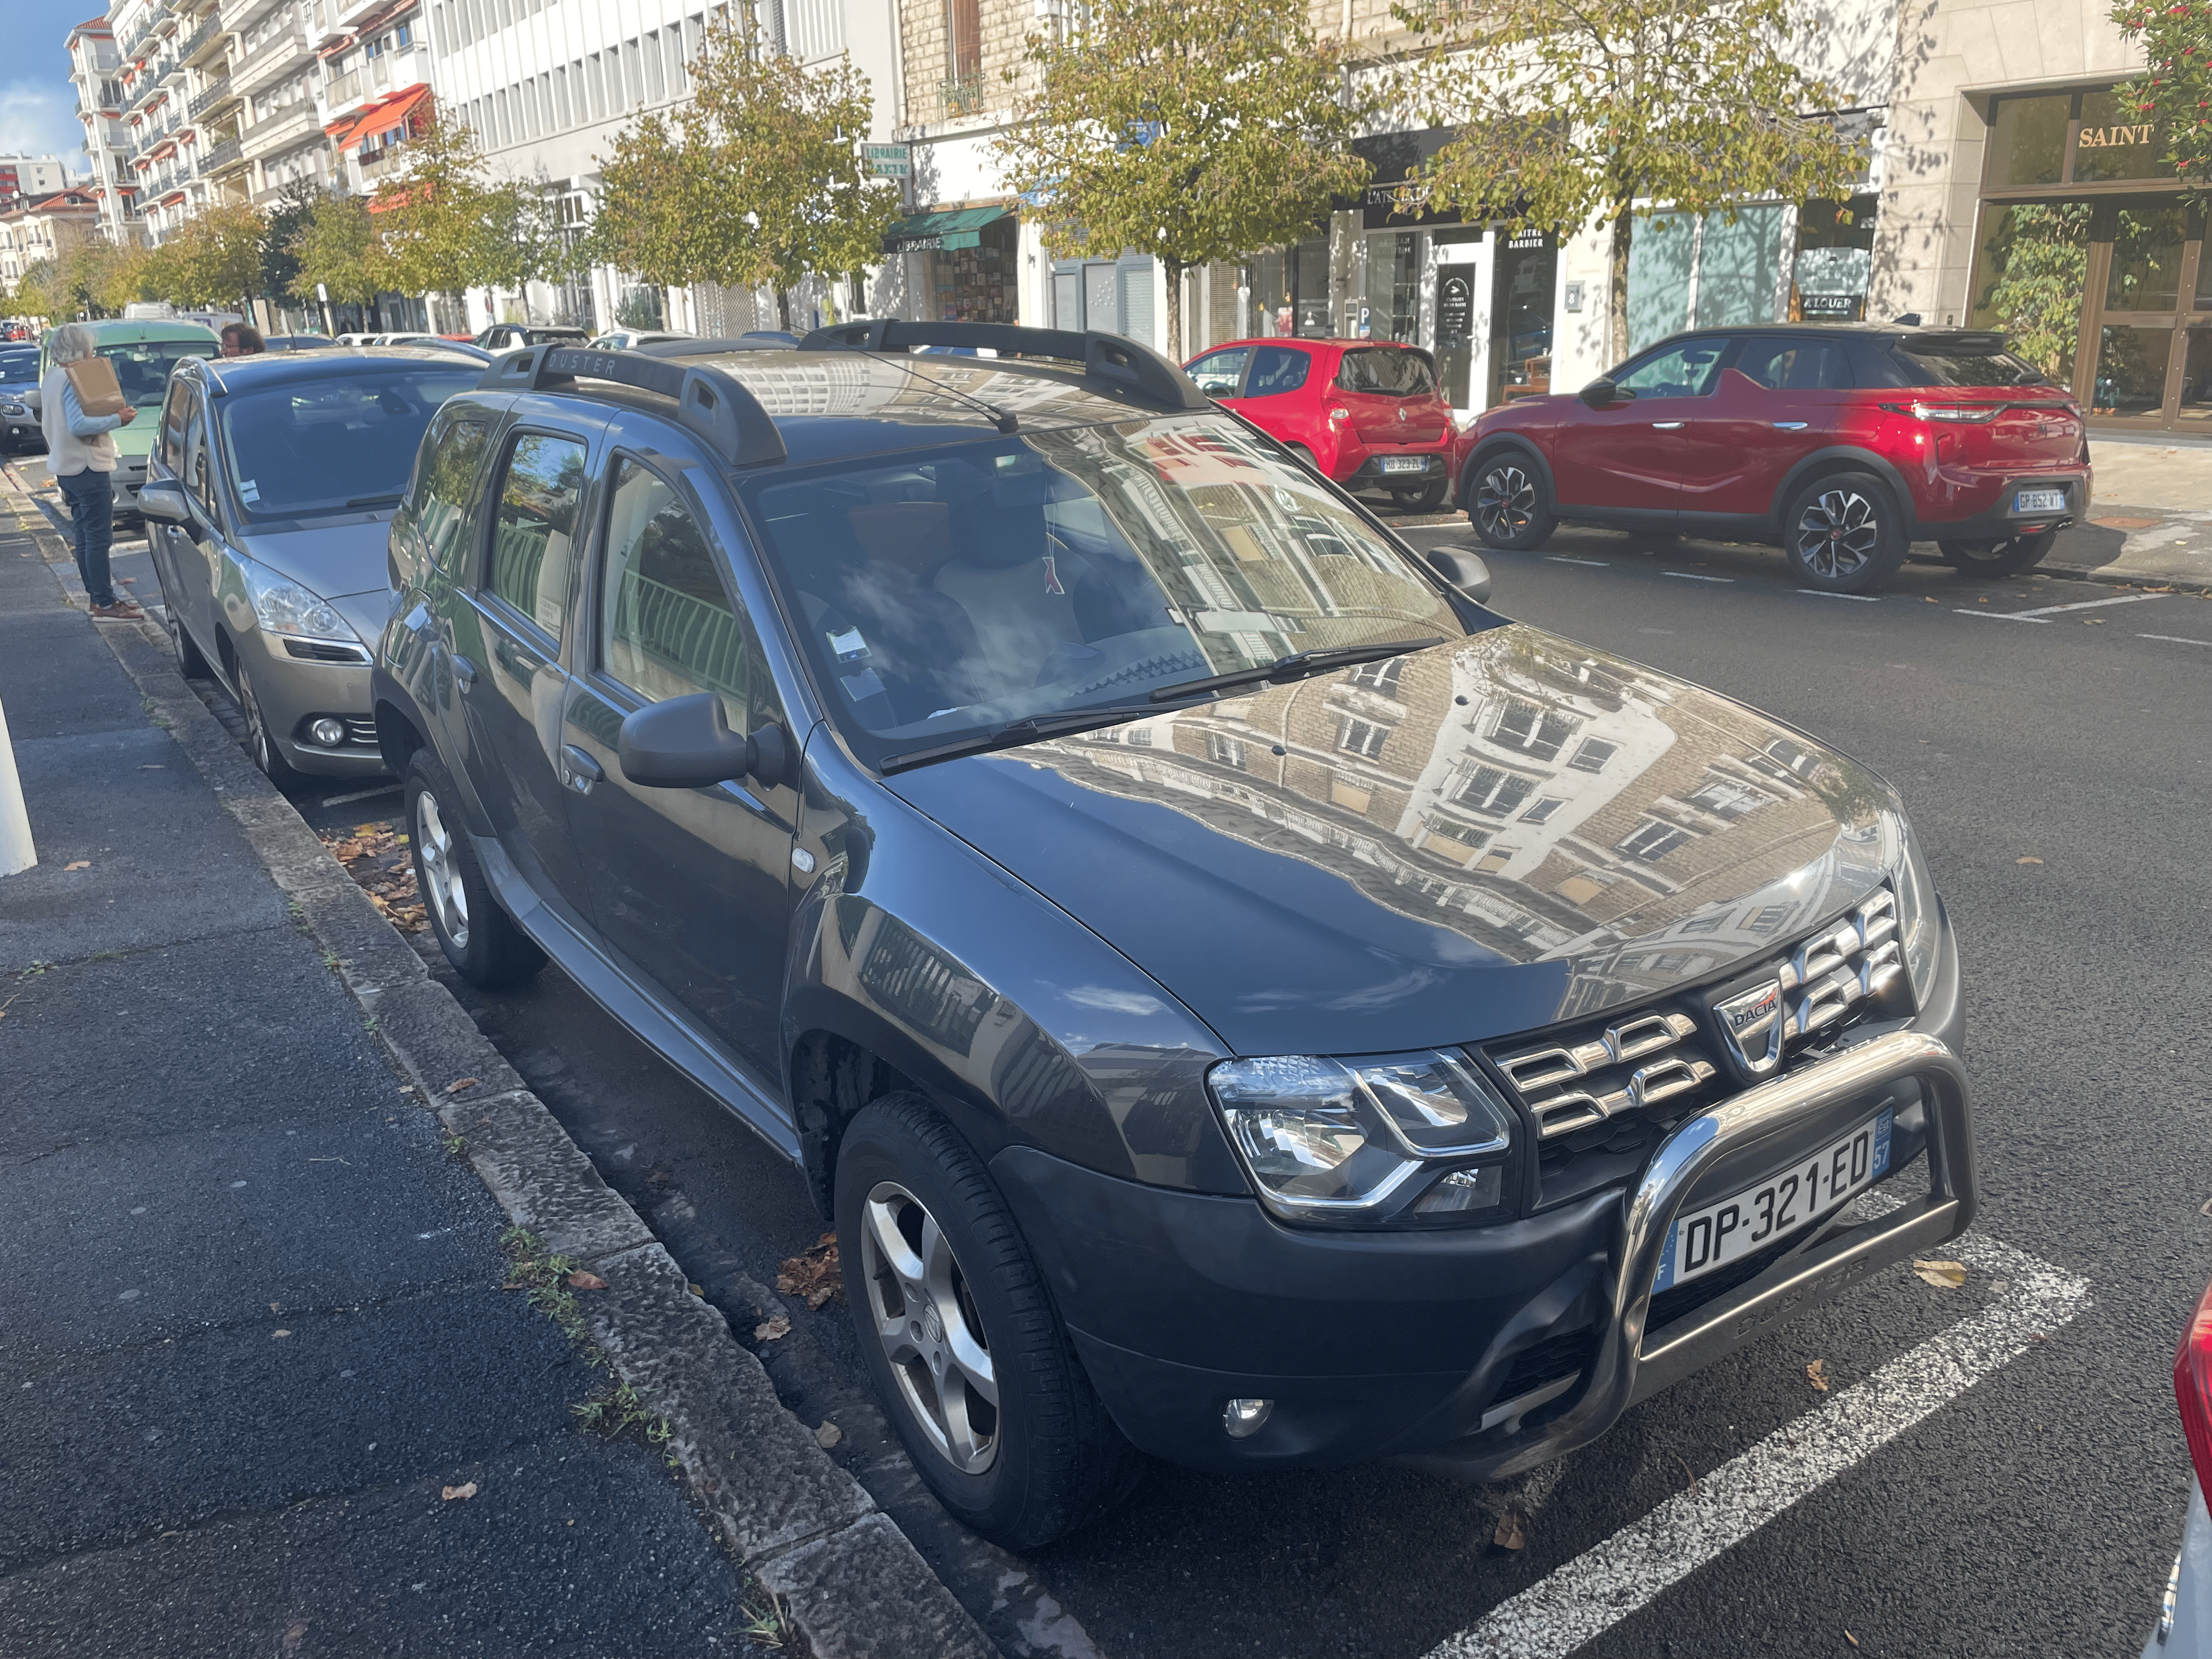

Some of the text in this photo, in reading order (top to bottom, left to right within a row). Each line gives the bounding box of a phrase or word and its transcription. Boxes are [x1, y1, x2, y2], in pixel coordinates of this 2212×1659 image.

[2079, 124, 2154, 148] SAINT
[866, 148, 907, 159] LIBRAIRIE
[896, 237, 941, 253] LIBRAIRIE
[1508, 238, 1543, 249] BARBIER
[1568, 293, 1575, 304] 8
[1814, 297, 1852, 308] LOUER
[1361, 307, 1370, 324] P
[549, 353, 616, 375] DUSTER
[1734, 999, 1777, 1027] DACIA
[1657, 1130, 1890, 1281] F DP-321-ED 57
